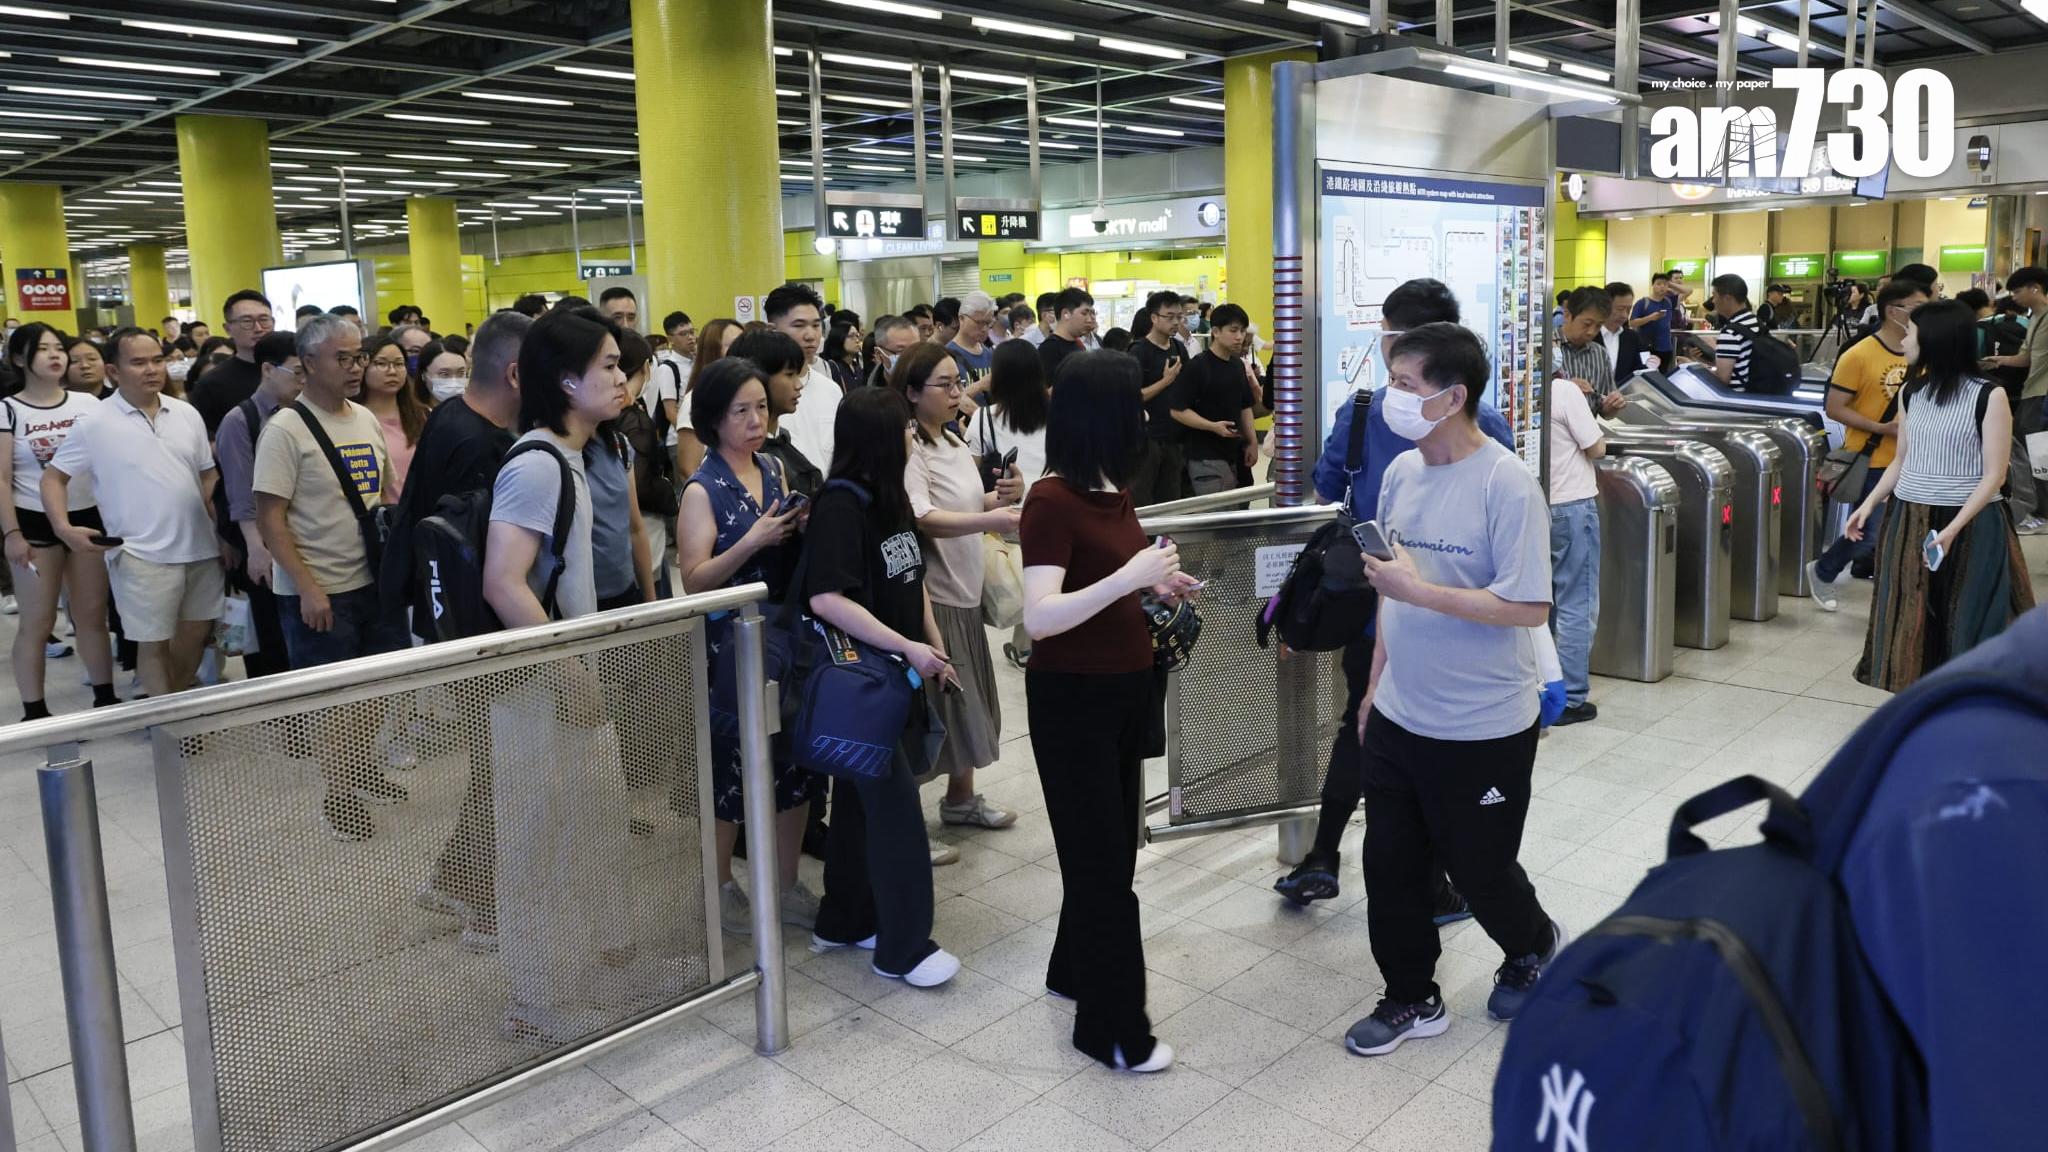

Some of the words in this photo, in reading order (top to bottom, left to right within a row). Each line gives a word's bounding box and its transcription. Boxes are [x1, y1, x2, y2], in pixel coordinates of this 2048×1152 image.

[1001, 215, 1027, 228] 升降機
[1138, 215, 1168, 233] mall
[429, 560, 444, 620] FILA
